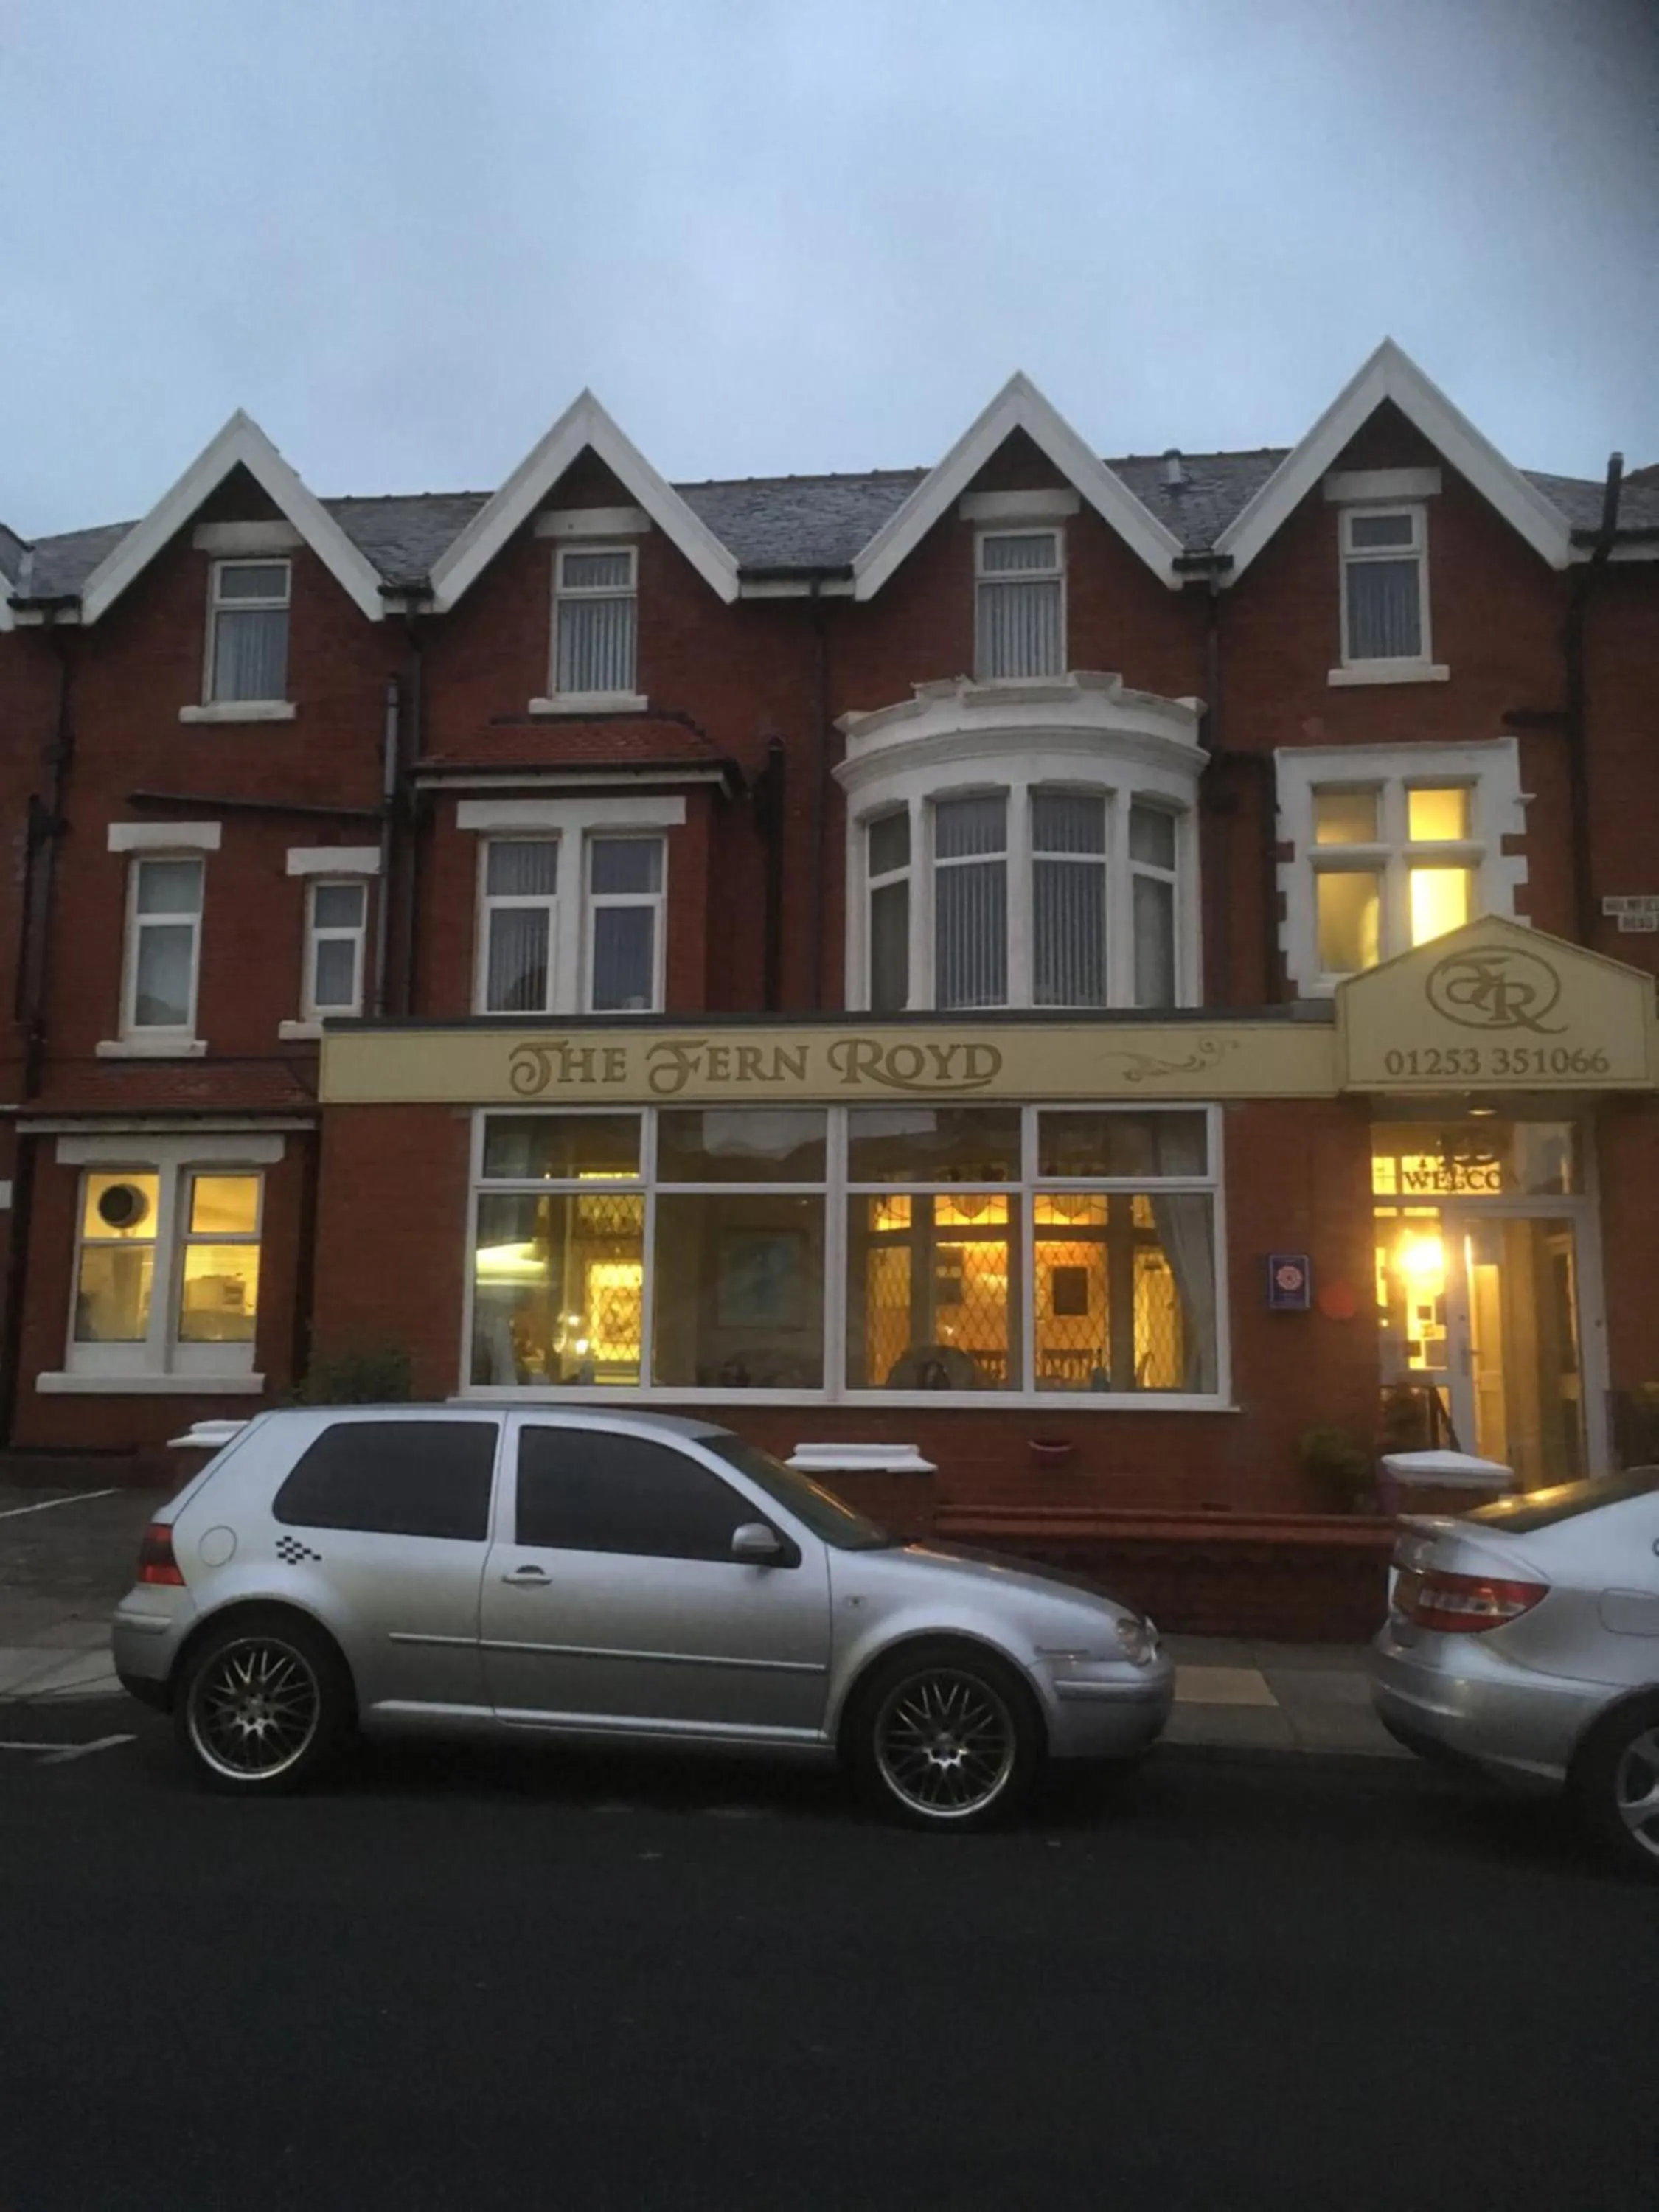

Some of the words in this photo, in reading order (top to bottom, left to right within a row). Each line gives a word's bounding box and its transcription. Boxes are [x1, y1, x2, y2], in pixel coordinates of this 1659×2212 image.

[509, 1040, 627, 1095] THE
[645, 1039, 810, 1093] FERN
[827, 1038, 1003, 1091] ROYD
[1384, 1048, 1481, 1076] 01253
[1491, 1046, 1610, 1074] 351066
[1403, 1170, 1520, 1192] WELCO
